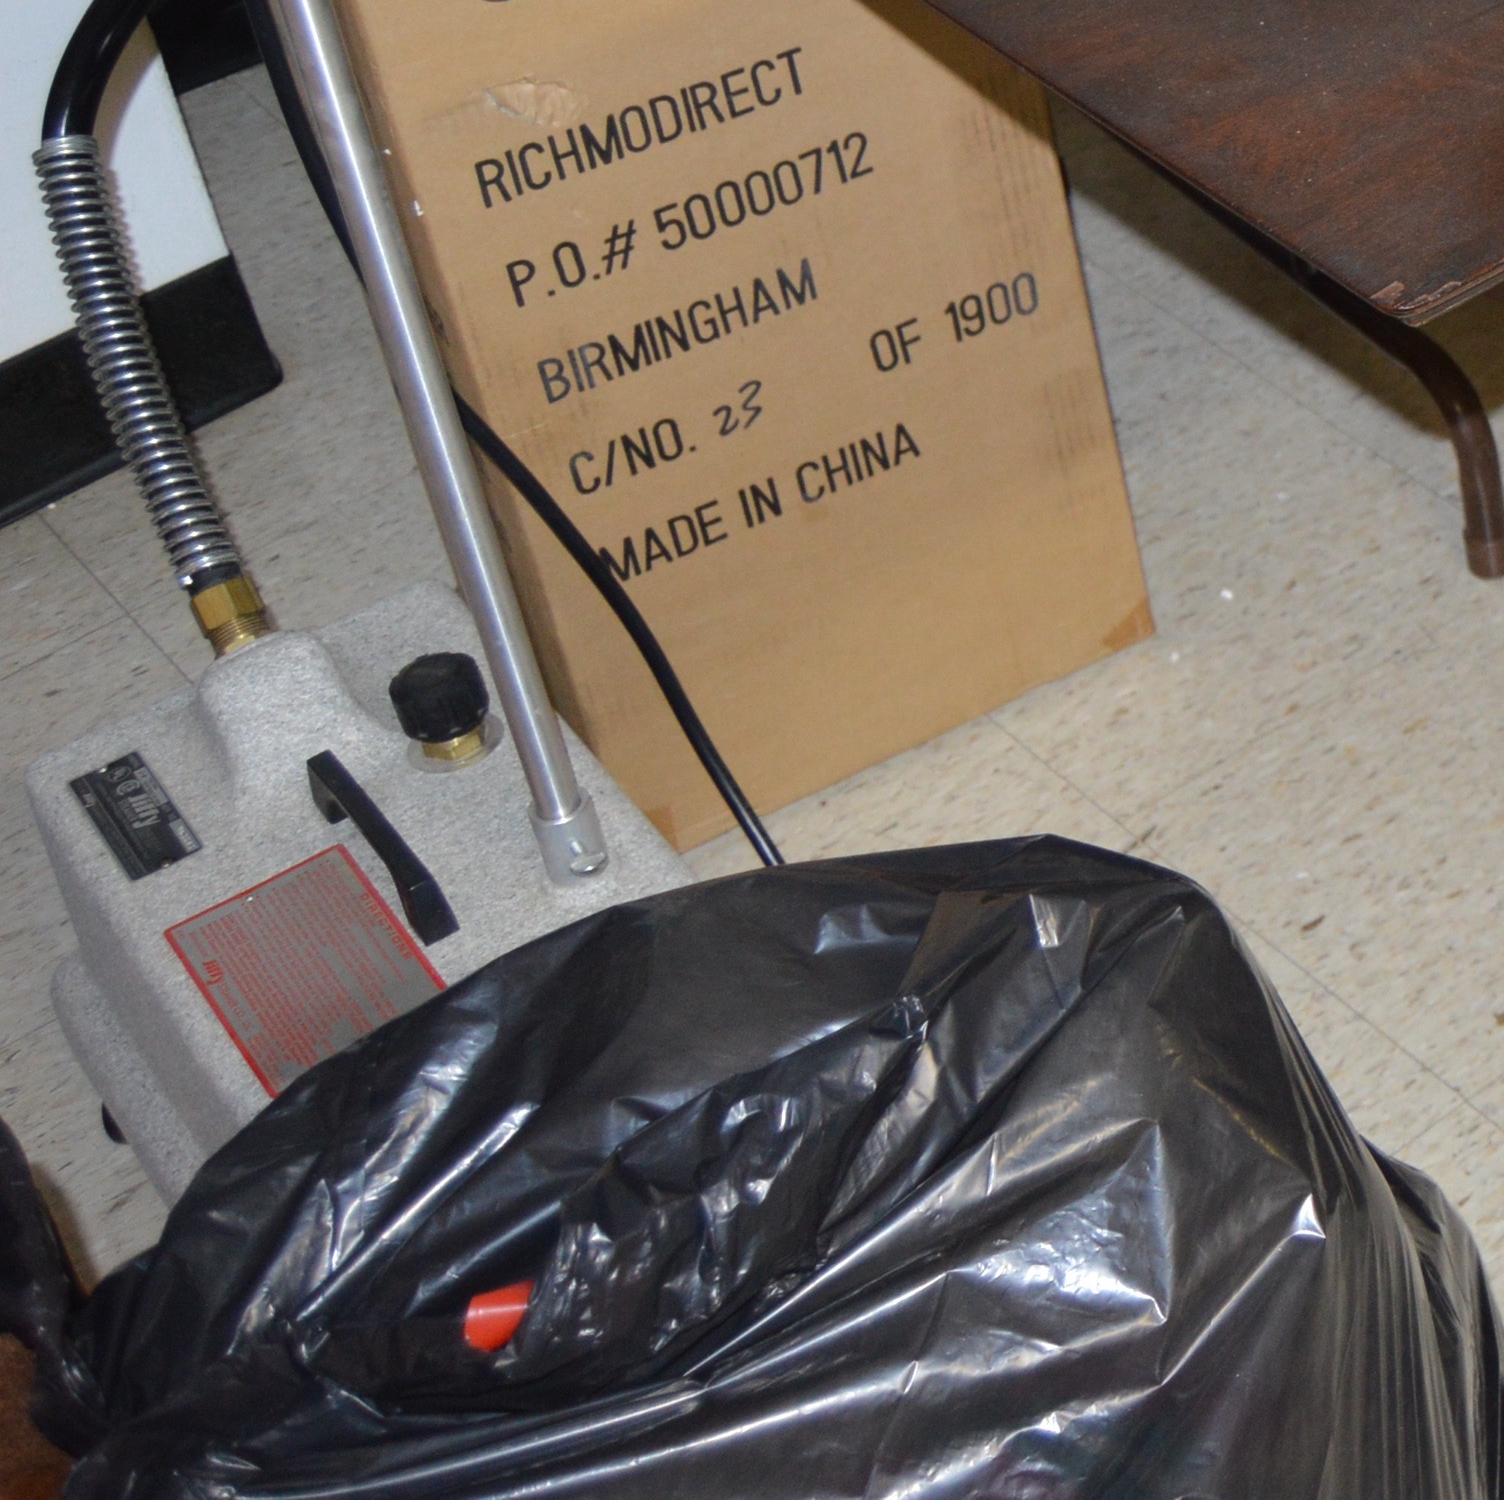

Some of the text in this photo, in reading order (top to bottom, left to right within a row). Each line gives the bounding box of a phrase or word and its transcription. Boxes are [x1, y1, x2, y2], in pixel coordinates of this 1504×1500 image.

[474, 46, 803, 208] RICHMODIRECT
[506, 132, 873, 307] P.O.# 50000712
[537, 257, 818, 403] BIRMINGHAM
[569, 272, 1039, 494] C/NO. 23 OF 1900
[598, 423, 921, 583] MADE IN CHINA
[361, 892, 413, 960] DIRECTIONS
